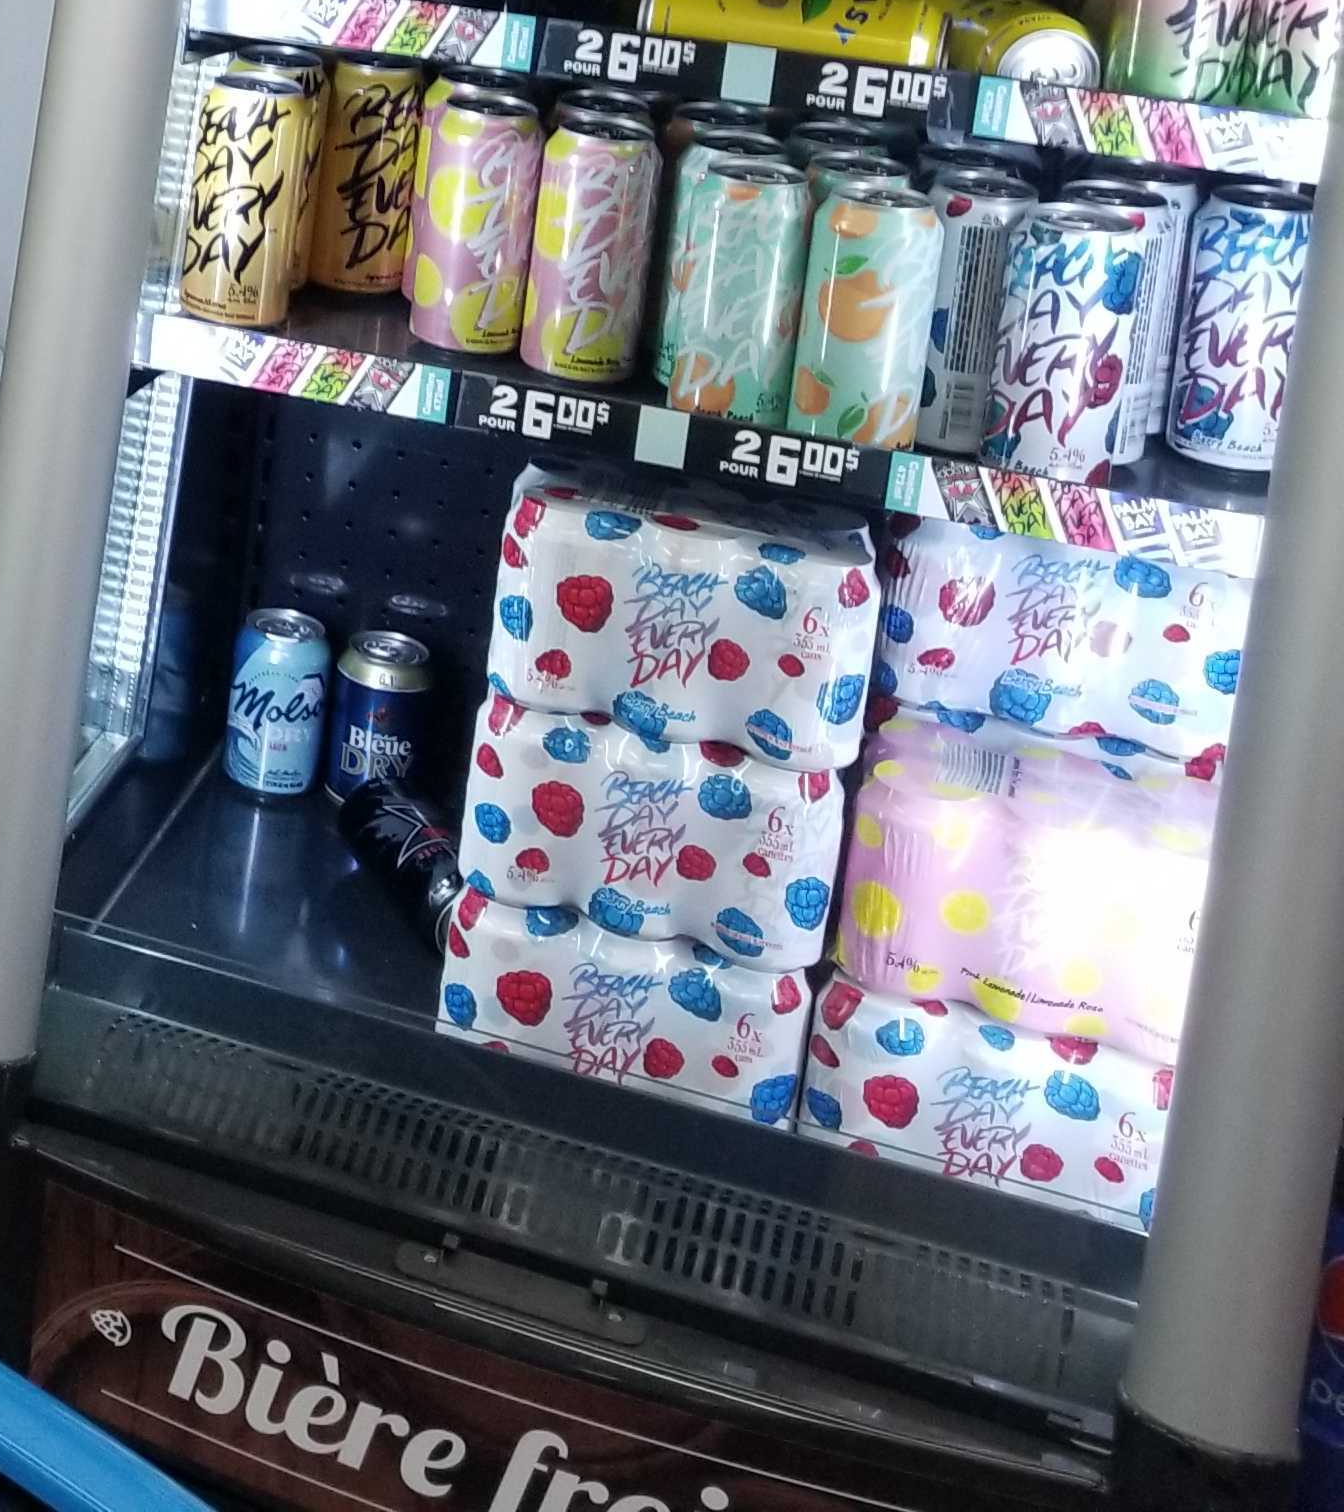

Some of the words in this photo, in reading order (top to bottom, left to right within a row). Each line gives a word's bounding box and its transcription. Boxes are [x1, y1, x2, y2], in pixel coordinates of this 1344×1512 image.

[575, 29, 604, 63] 2
[563, 60, 602, 77] POUR
[818, 62, 849, 97] 2
[806, 93, 846, 111] POUR
[489, 384, 519, 419] 2
[478, 414, 516, 433] POUR
[731, 429, 762, 464] 2
[719, 460, 759, 479] POUR
[632, 562, 728, 598] BEACH
[624, 592, 712, 628] DAY
[625, 618, 720, 657] EVERY
[627, 648, 706, 688] DAY
[349, 724, 412, 756] Bleue
[341, 742, 412, 780] DRY
[599, 770, 693, 806] BEACH
[595, 798, 679, 838] DAY
[597, 824, 688, 865] EVERY
[599, 854, 676, 886] DAY
[564, 991, 649, 1026] DAY
[568, 1049, 642, 1085] DAY
[931, 1098, 1024, 1133] DAY
[939, 1149, 1019, 1187] DAY
[160, 1302, 467, 1501] Bière
